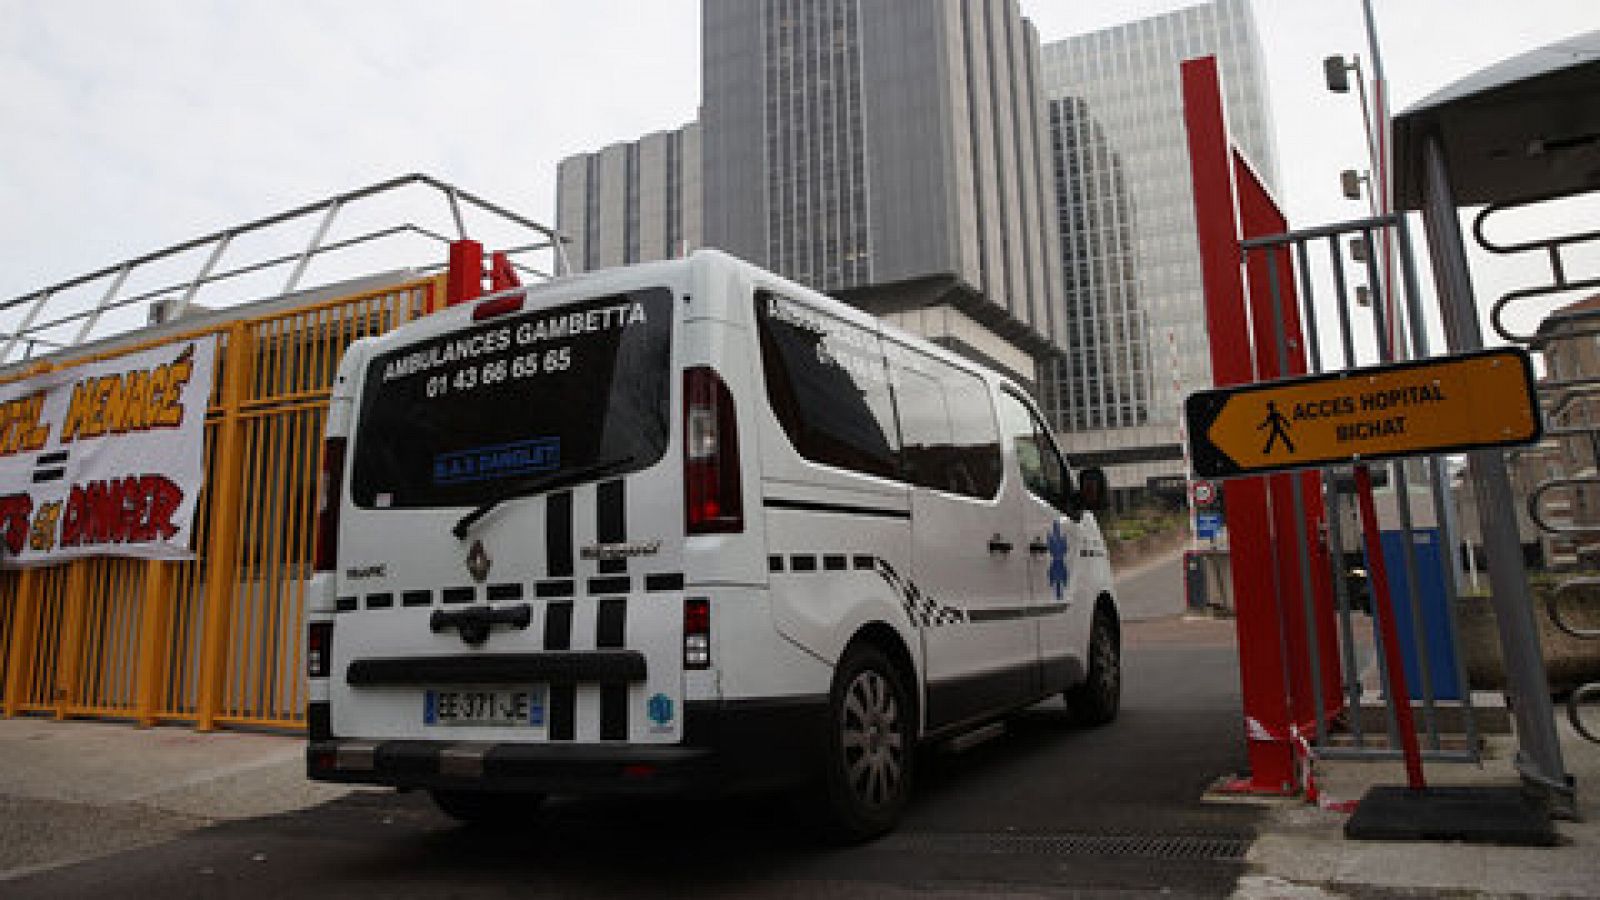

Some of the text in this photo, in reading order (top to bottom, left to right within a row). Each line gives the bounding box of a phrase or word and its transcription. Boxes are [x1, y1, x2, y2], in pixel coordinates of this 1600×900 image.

[383, 302, 648, 383] AMBULANCES GAMBETTA
[426, 373, 447, 397] 01
[453, 366, 478, 390] 43
[512, 353, 537, 377] 65
[543, 346, 571, 372] 65
[1336, 416, 1407, 442] BICHAT
[60, 473, 184, 547] DANGER
